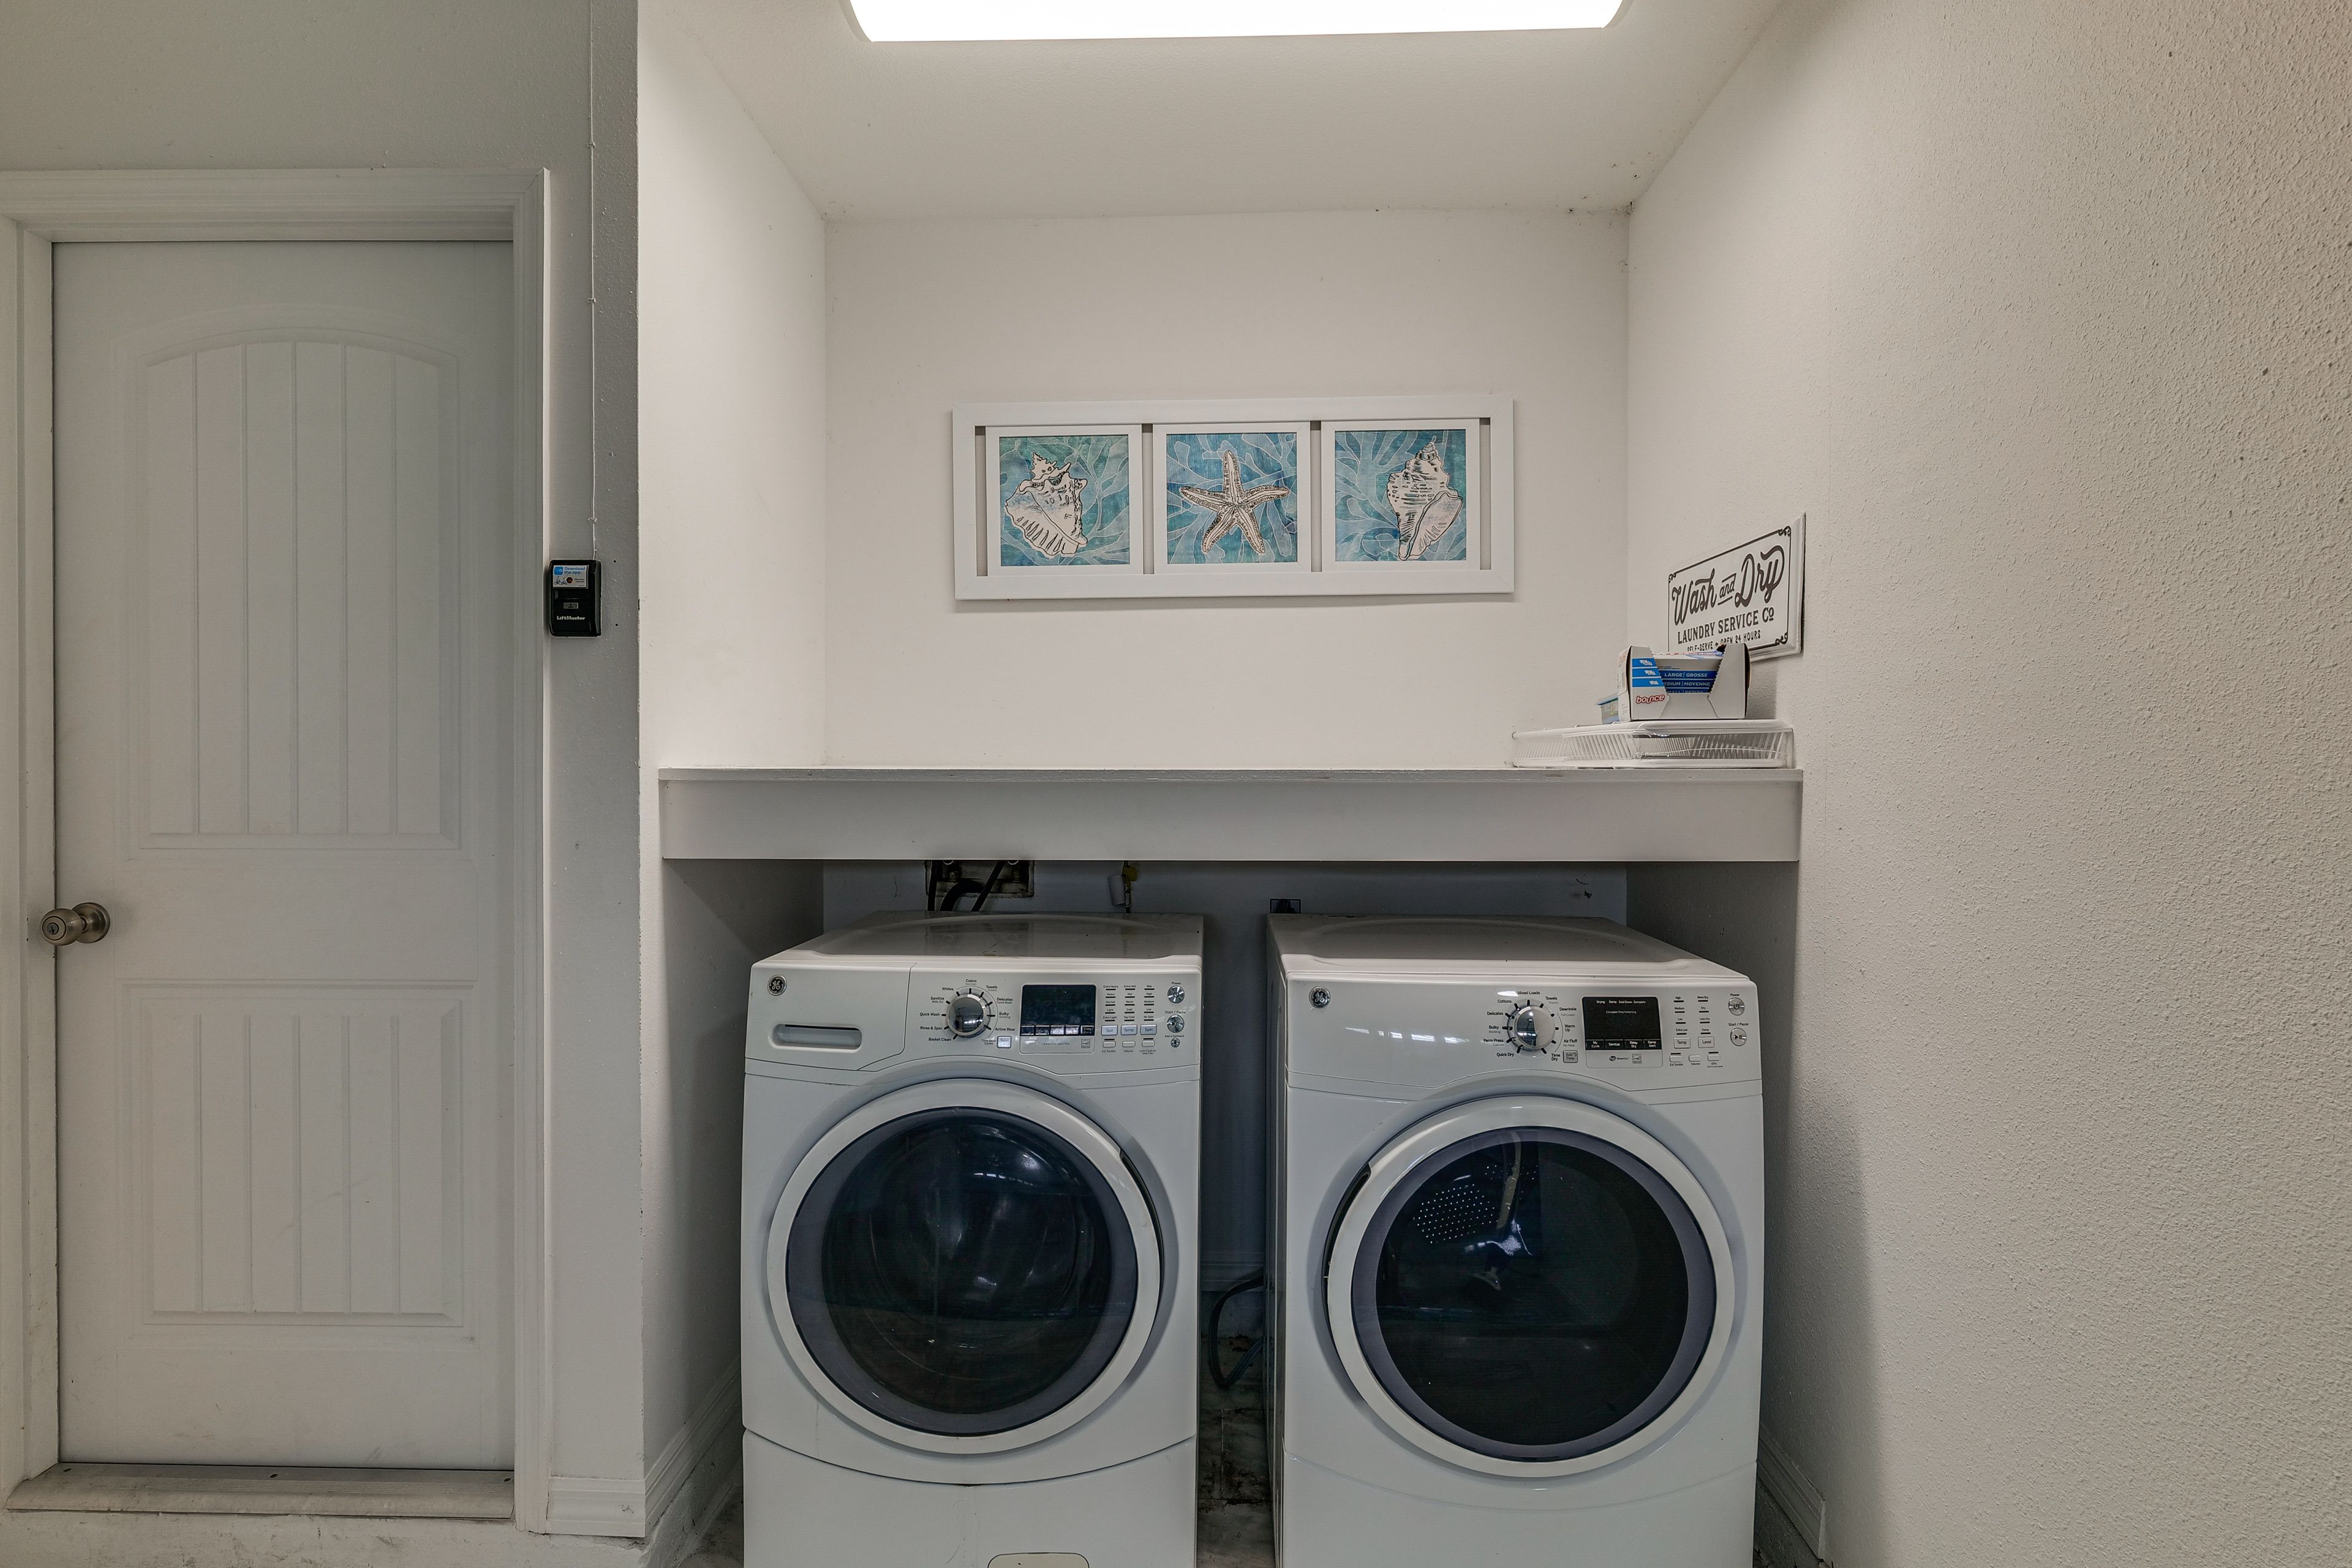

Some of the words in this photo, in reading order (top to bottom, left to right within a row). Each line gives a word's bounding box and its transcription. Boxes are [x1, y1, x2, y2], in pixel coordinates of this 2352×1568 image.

[1672, 568, 1717, 625] Wash
[1719, 573, 1736, 599] and
[1735, 545, 1784, 608] Dry
[1678, 622, 1716, 644] LAUNDRY
[1718, 609, 1758, 634] SERVICE
[1735, 635, 1741, 644] 24
[1743, 630, 1761, 642] HOURS
[1636, 694, 1665, 704] bounce
